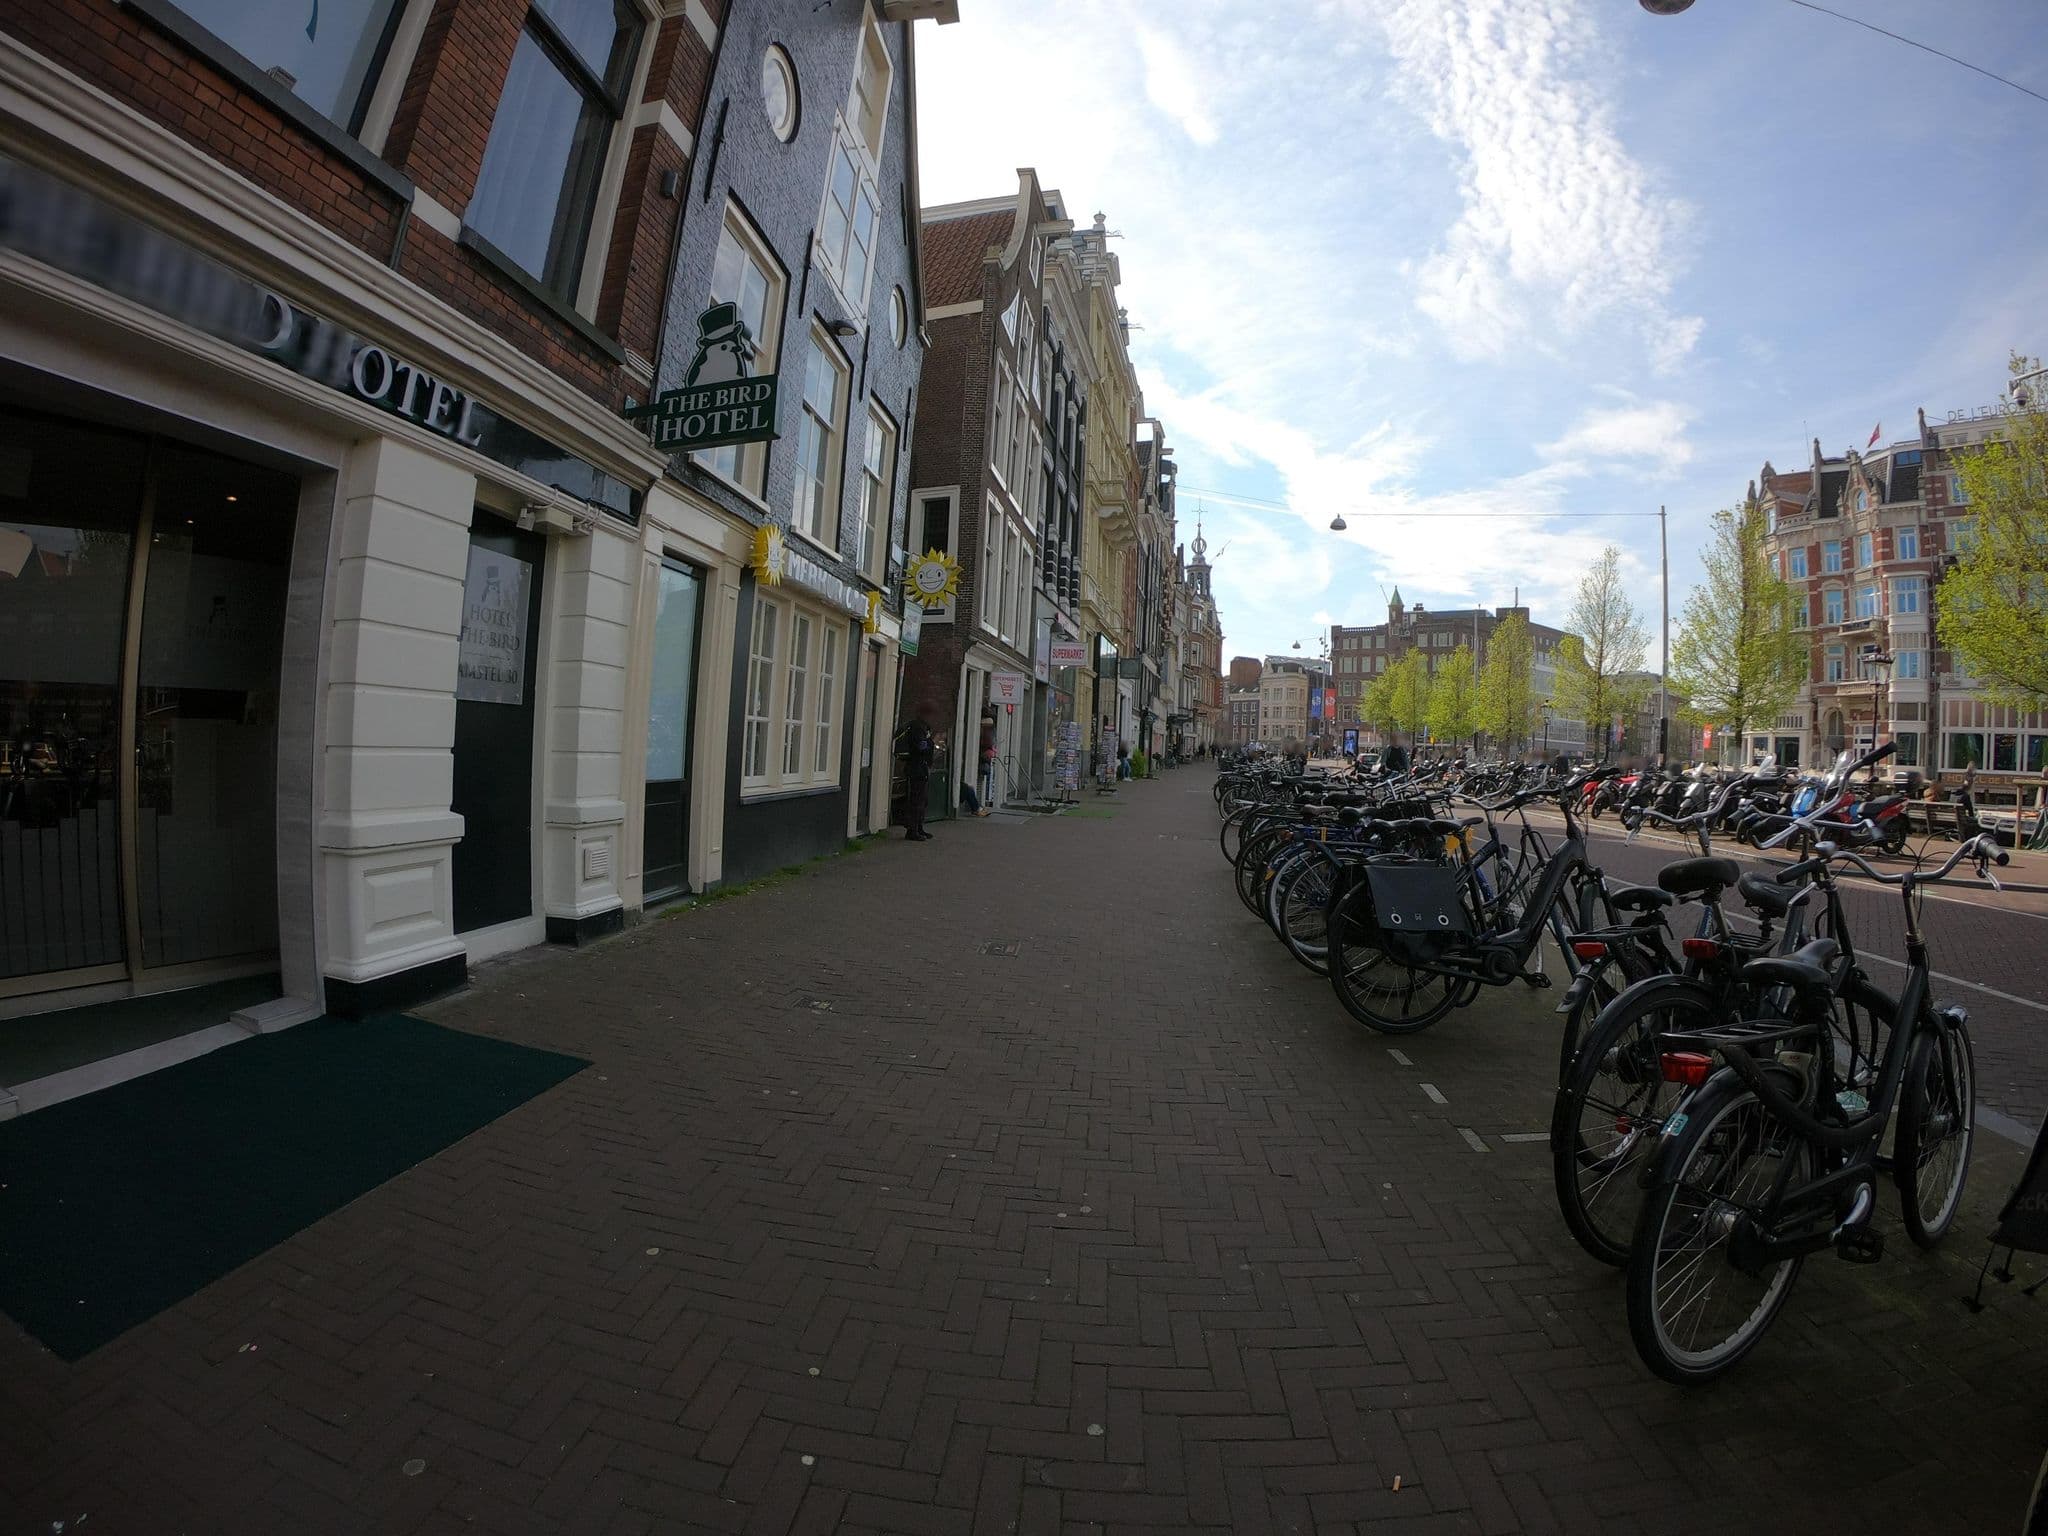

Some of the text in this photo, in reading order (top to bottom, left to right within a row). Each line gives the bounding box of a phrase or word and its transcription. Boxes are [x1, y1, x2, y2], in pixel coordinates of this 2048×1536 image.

[303, 317, 482, 447] OTEL
[663, 383, 772, 415] THE BIRD
[659, 405, 769, 442] HOTEL
[470, 604, 513, 628] HOTEL
[488, 631, 521, 651] BIRD
[1051, 648, 1085, 660] SUPERMARKET
[504, 669, 519, 685] 30
